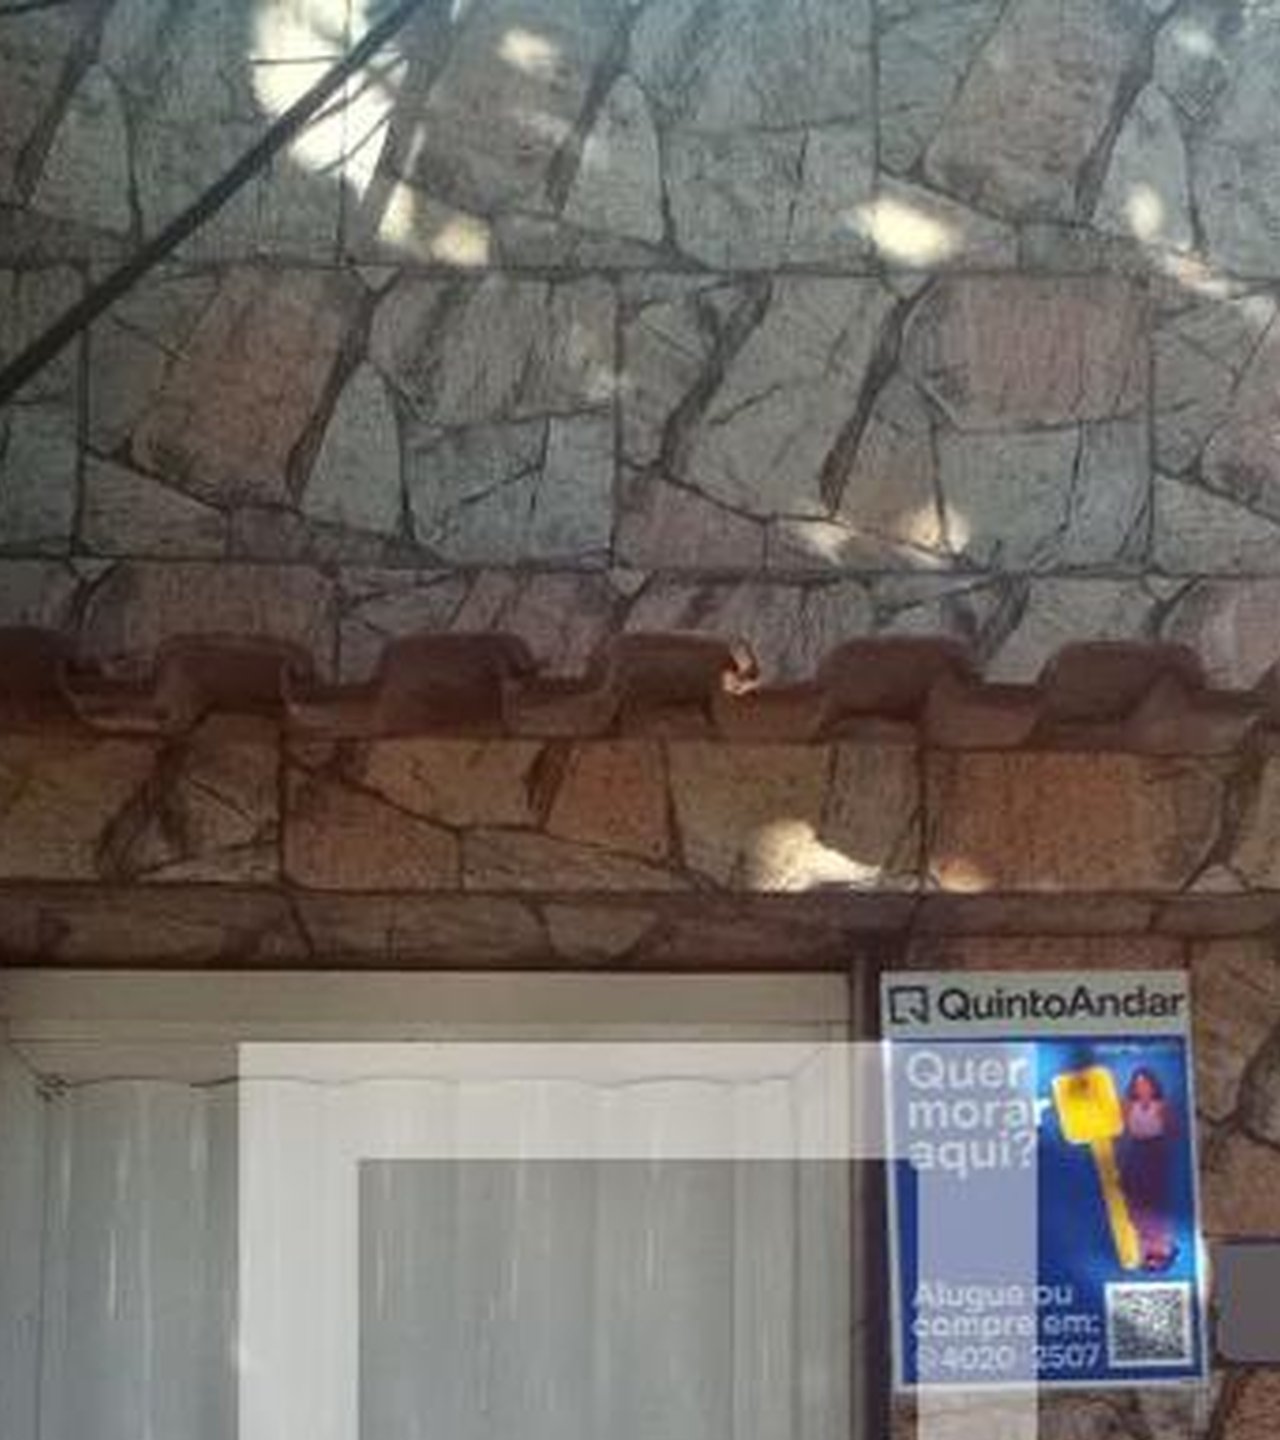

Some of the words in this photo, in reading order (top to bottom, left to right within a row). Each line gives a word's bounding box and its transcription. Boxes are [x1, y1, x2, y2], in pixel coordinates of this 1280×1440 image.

[938, 986, 1185, 1021] QuintoAndar
[906, 1052, 1029, 1090] Quer
[908, 1097, 1051, 1130] morar
[909, 1131, 1033, 1179] aqui?
[913, 1283, 1027, 1312] Alugue
[1033, 1286, 1072, 1307] ou
[913, 1315, 1035, 1338] compre
[1042, 1315, 1101, 1333] em:
